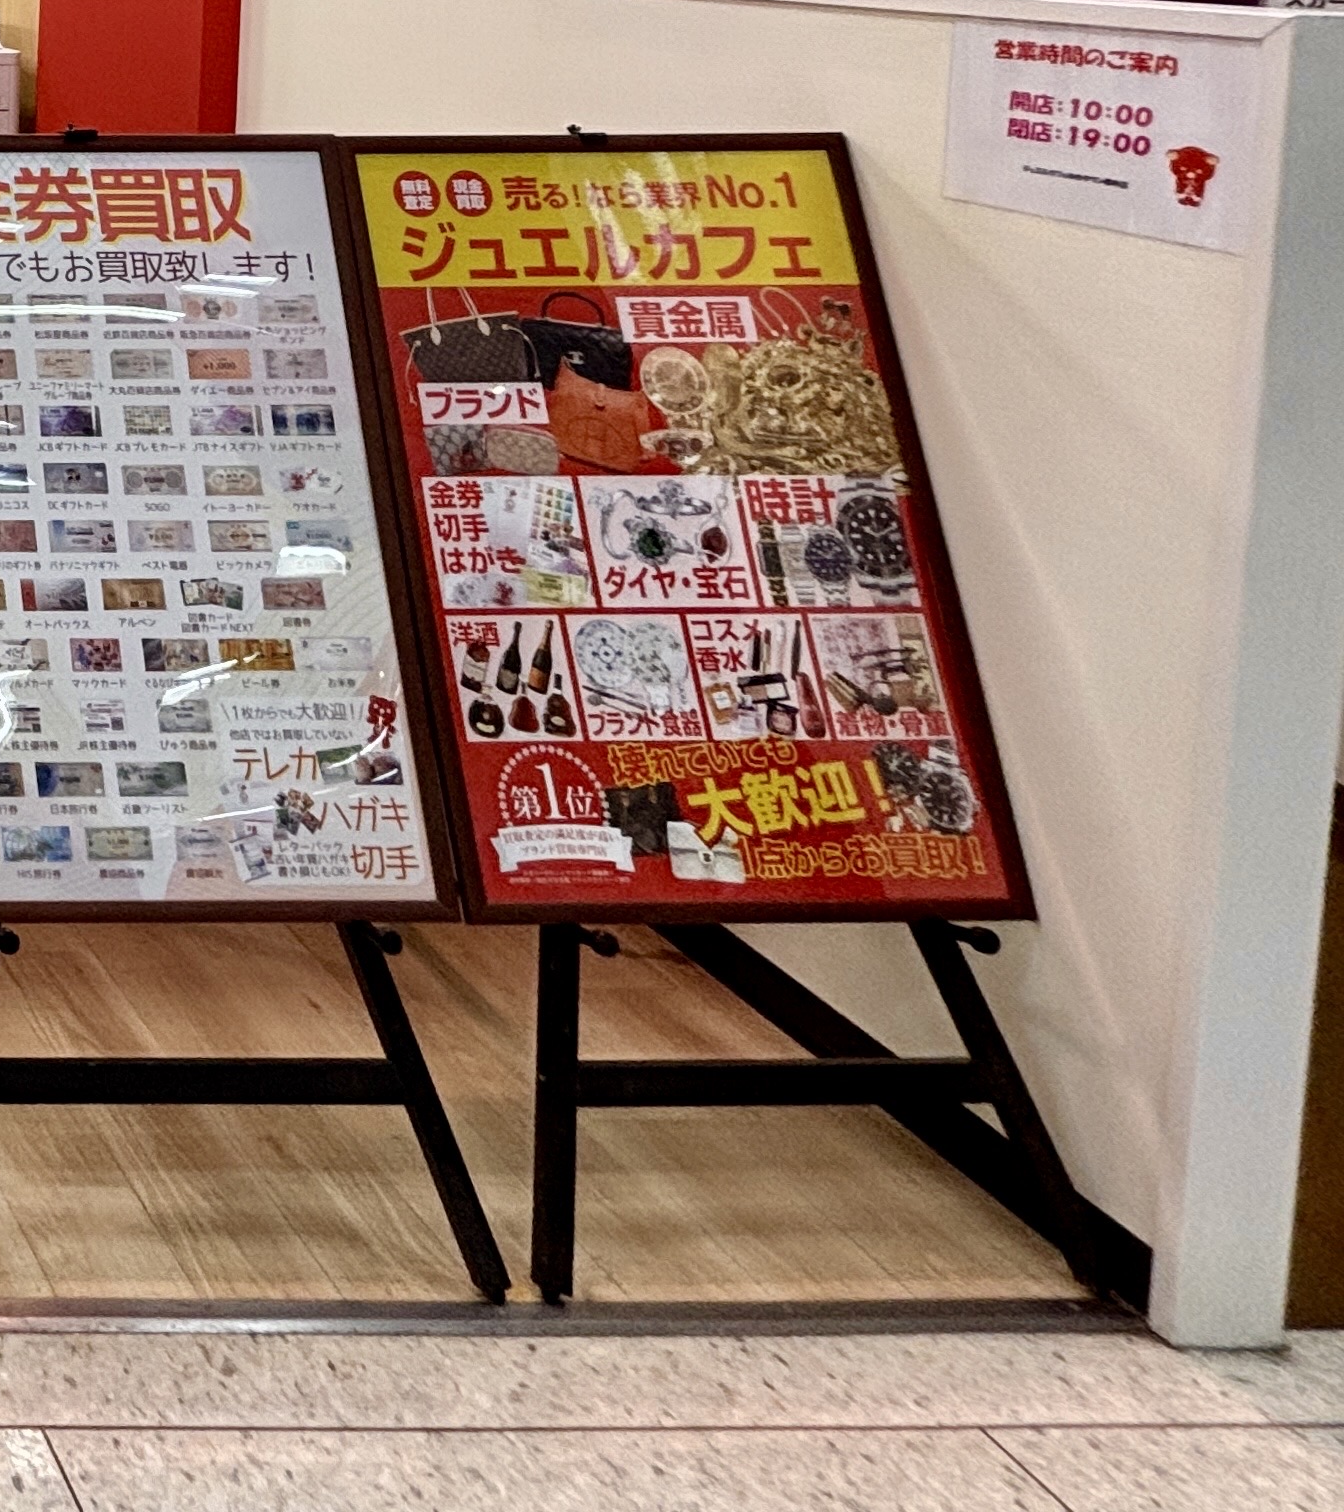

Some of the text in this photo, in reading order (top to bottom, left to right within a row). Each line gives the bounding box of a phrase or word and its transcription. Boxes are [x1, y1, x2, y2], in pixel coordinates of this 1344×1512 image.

[994, 39, 1179, 77] 営業時間のご案内
[401, 221, 822, 282] ジュエルカフェ
[629, 301, 747, 339] 貴金属
[424, 387, 544, 419] ブランド
[428, 480, 483, 509] 金券
[744, 478, 836, 526] 時計
[434, 514, 490, 542] 切手
[439, 545, 527, 575] はがき
[449, 620, 500, 648] 洋酒
[690, 619, 762, 642] コスメ
[695, 646, 747, 674] 香水
[233, 745, 319, 781] テレカ
[510, 761, 600, 821] 第1位
[687, 760, 891, 842] 大歓迎!
[317, 796, 409, 832] ハガキ
[350, 844, 419, 880] 切手
